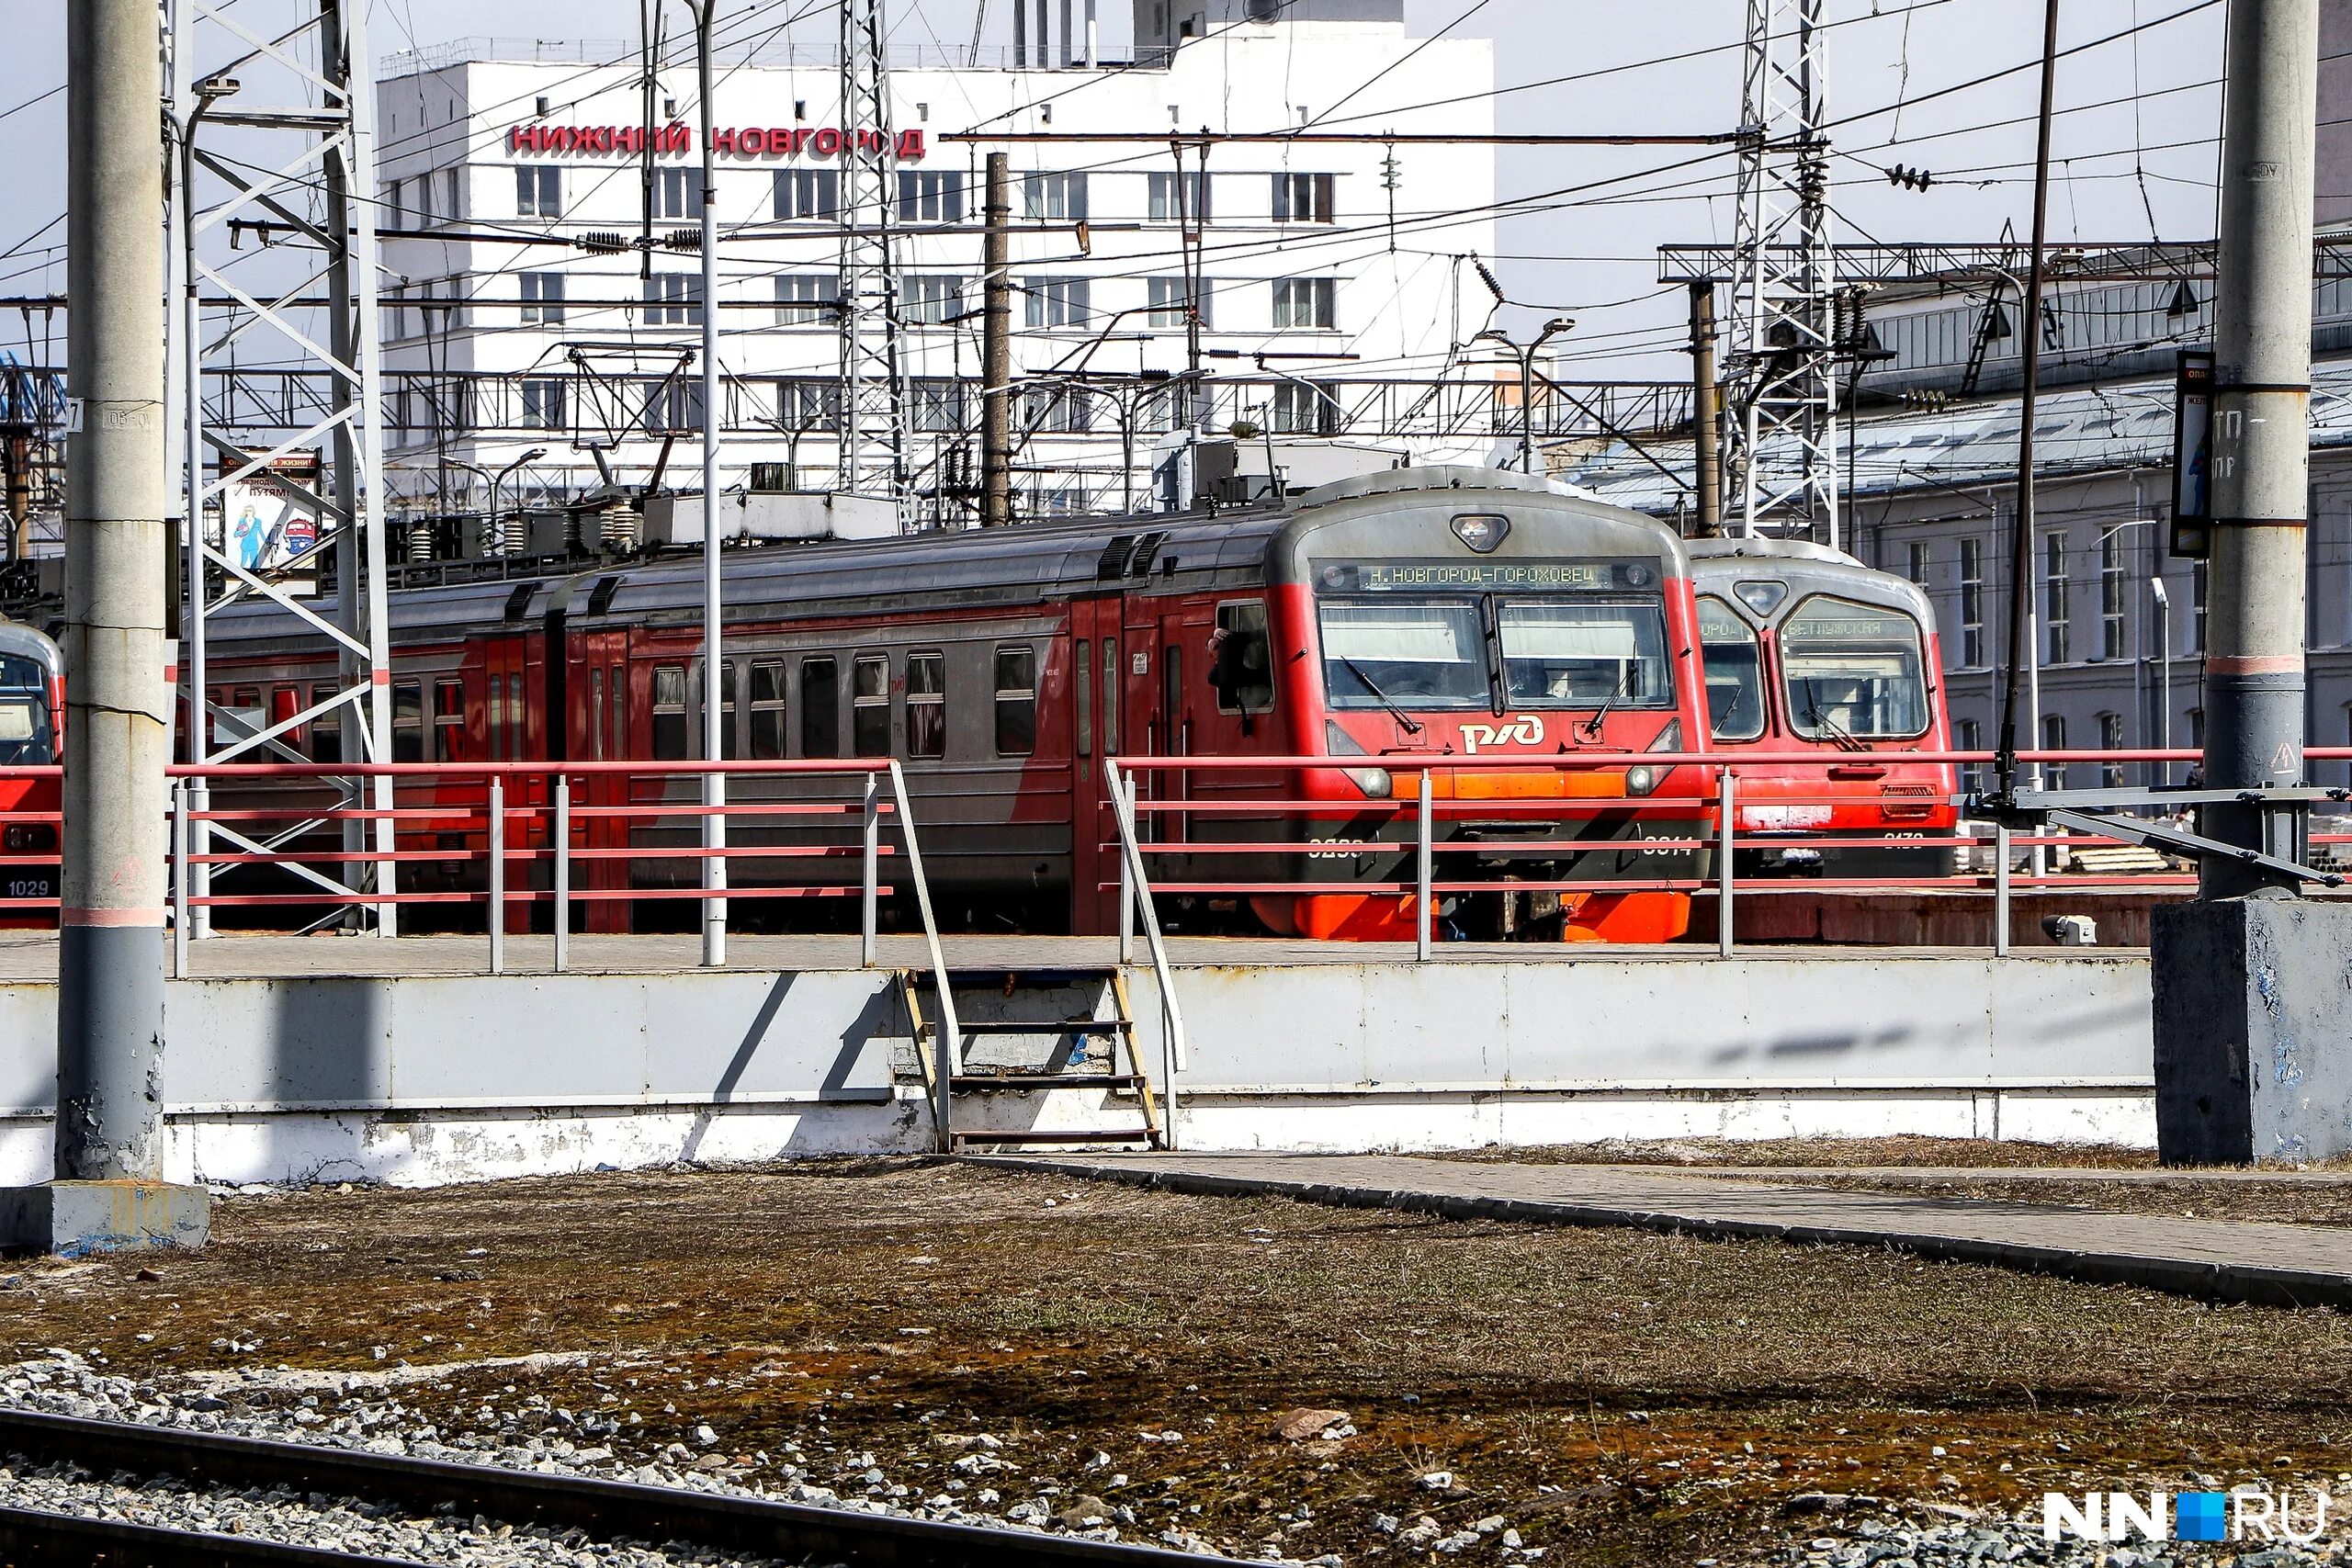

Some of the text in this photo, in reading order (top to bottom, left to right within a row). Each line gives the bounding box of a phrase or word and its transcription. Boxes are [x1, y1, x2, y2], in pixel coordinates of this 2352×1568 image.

[513, 120, 926, 159] НИЖНИЙ НОВГОРОД
[250, 488, 289, 497] ПУТЯМ!
[9, 881, 49, 897] 1029
